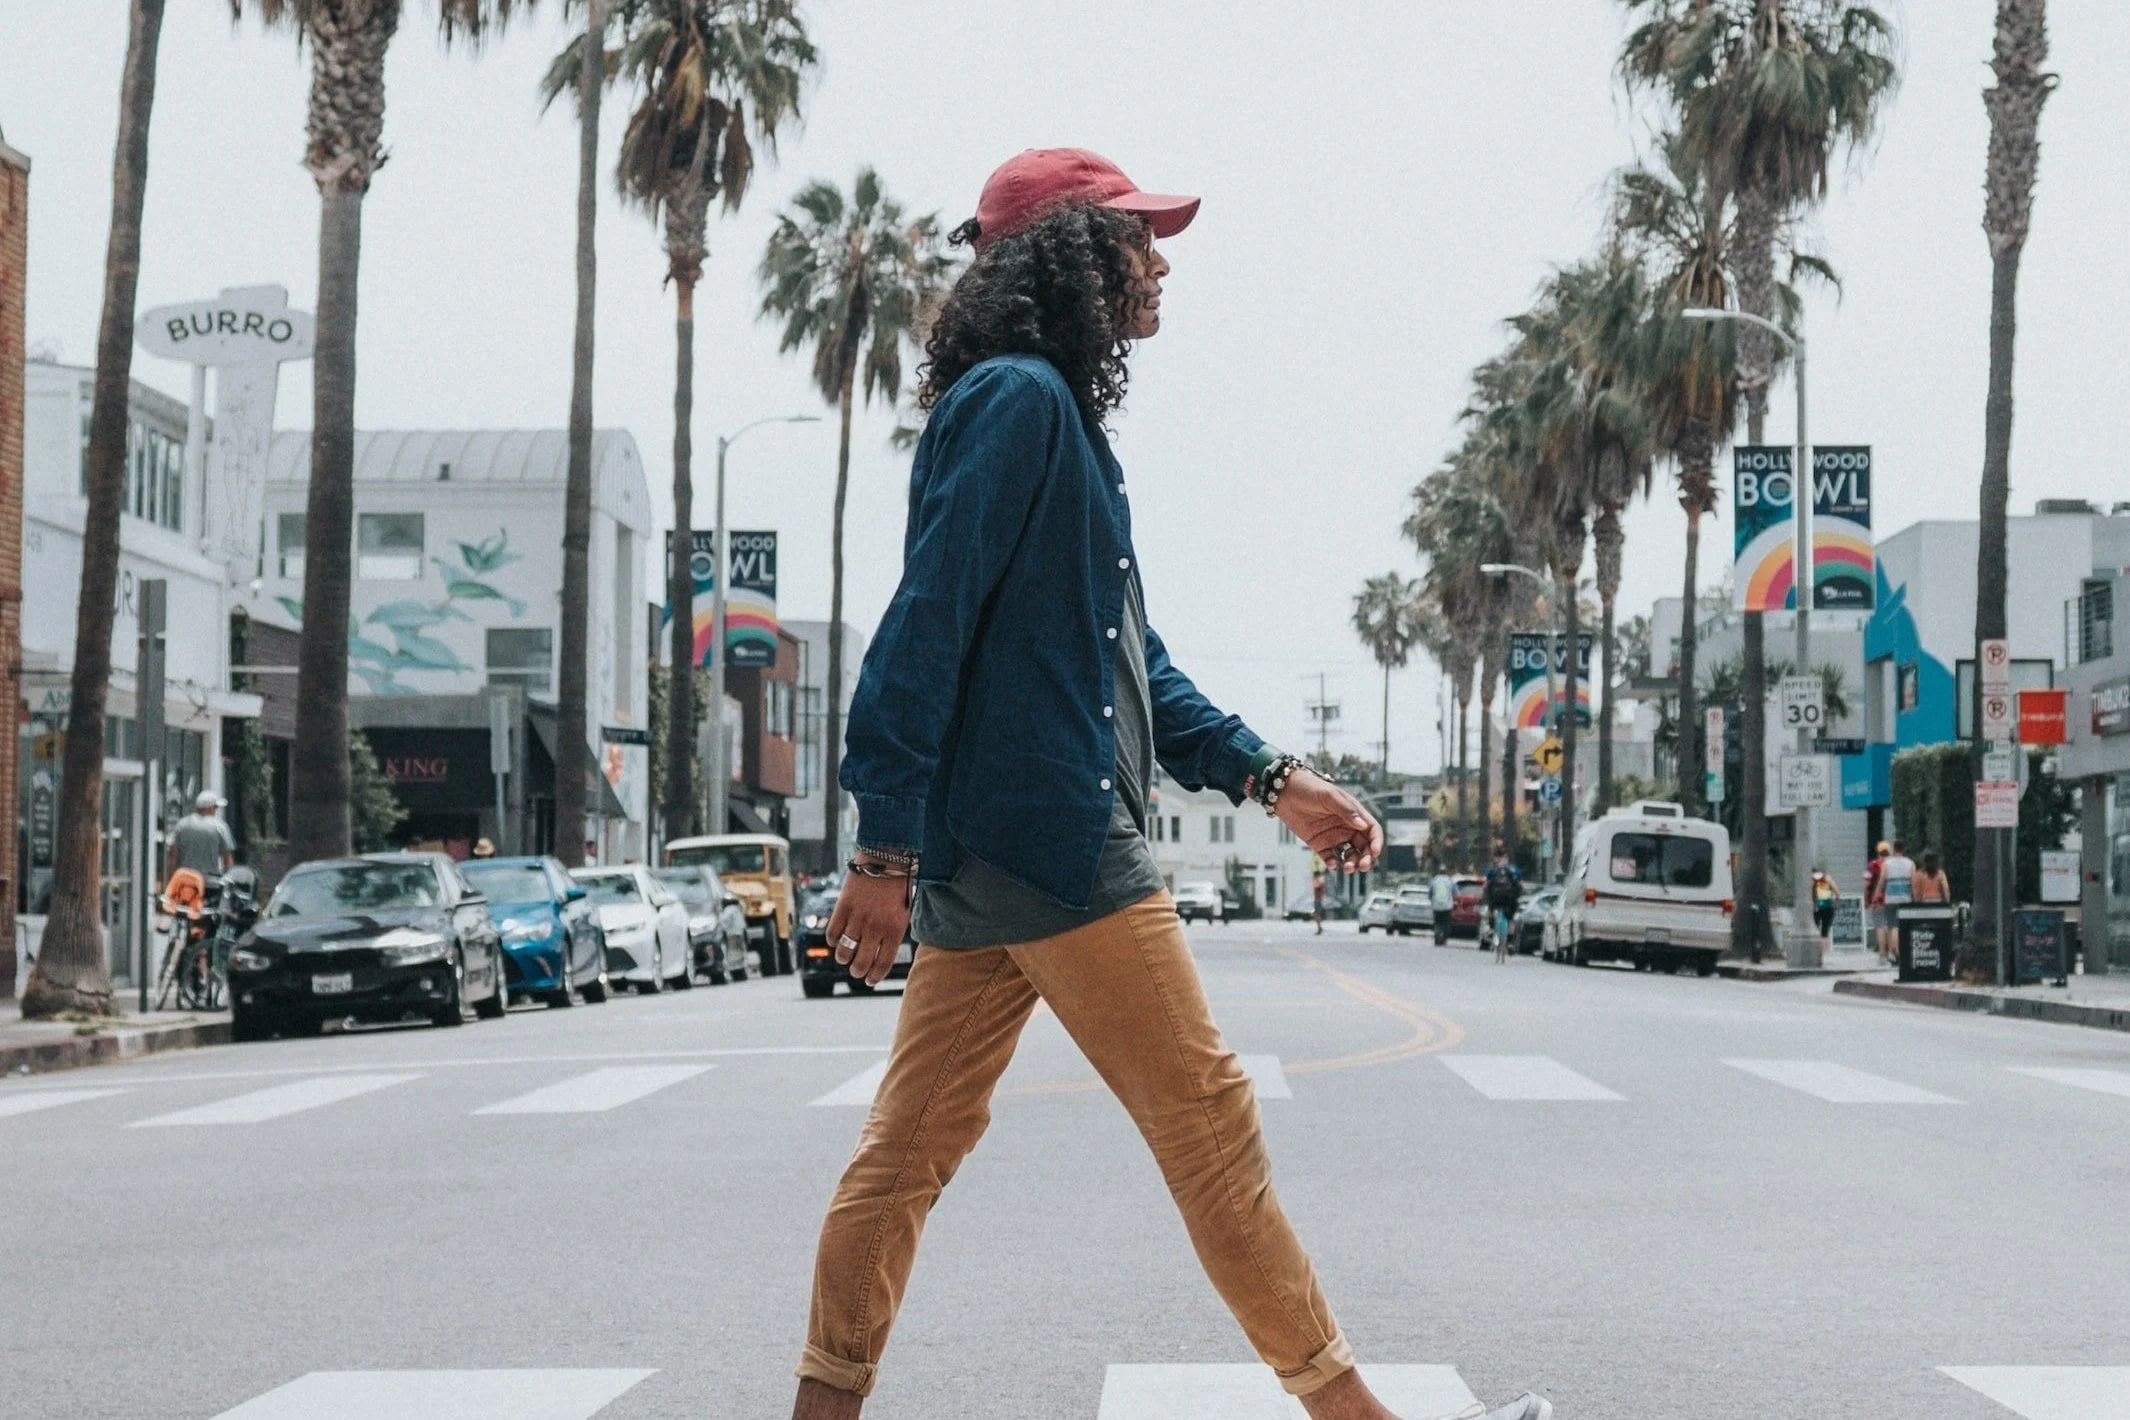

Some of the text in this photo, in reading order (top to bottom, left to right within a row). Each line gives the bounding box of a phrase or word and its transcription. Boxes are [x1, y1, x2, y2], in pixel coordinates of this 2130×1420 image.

[166, 309, 293, 343] BURRO
[1737, 471, 1868, 507] BOWL
[667, 551, 774, 581] OWL
[1787, 704, 1820, 724] 30
